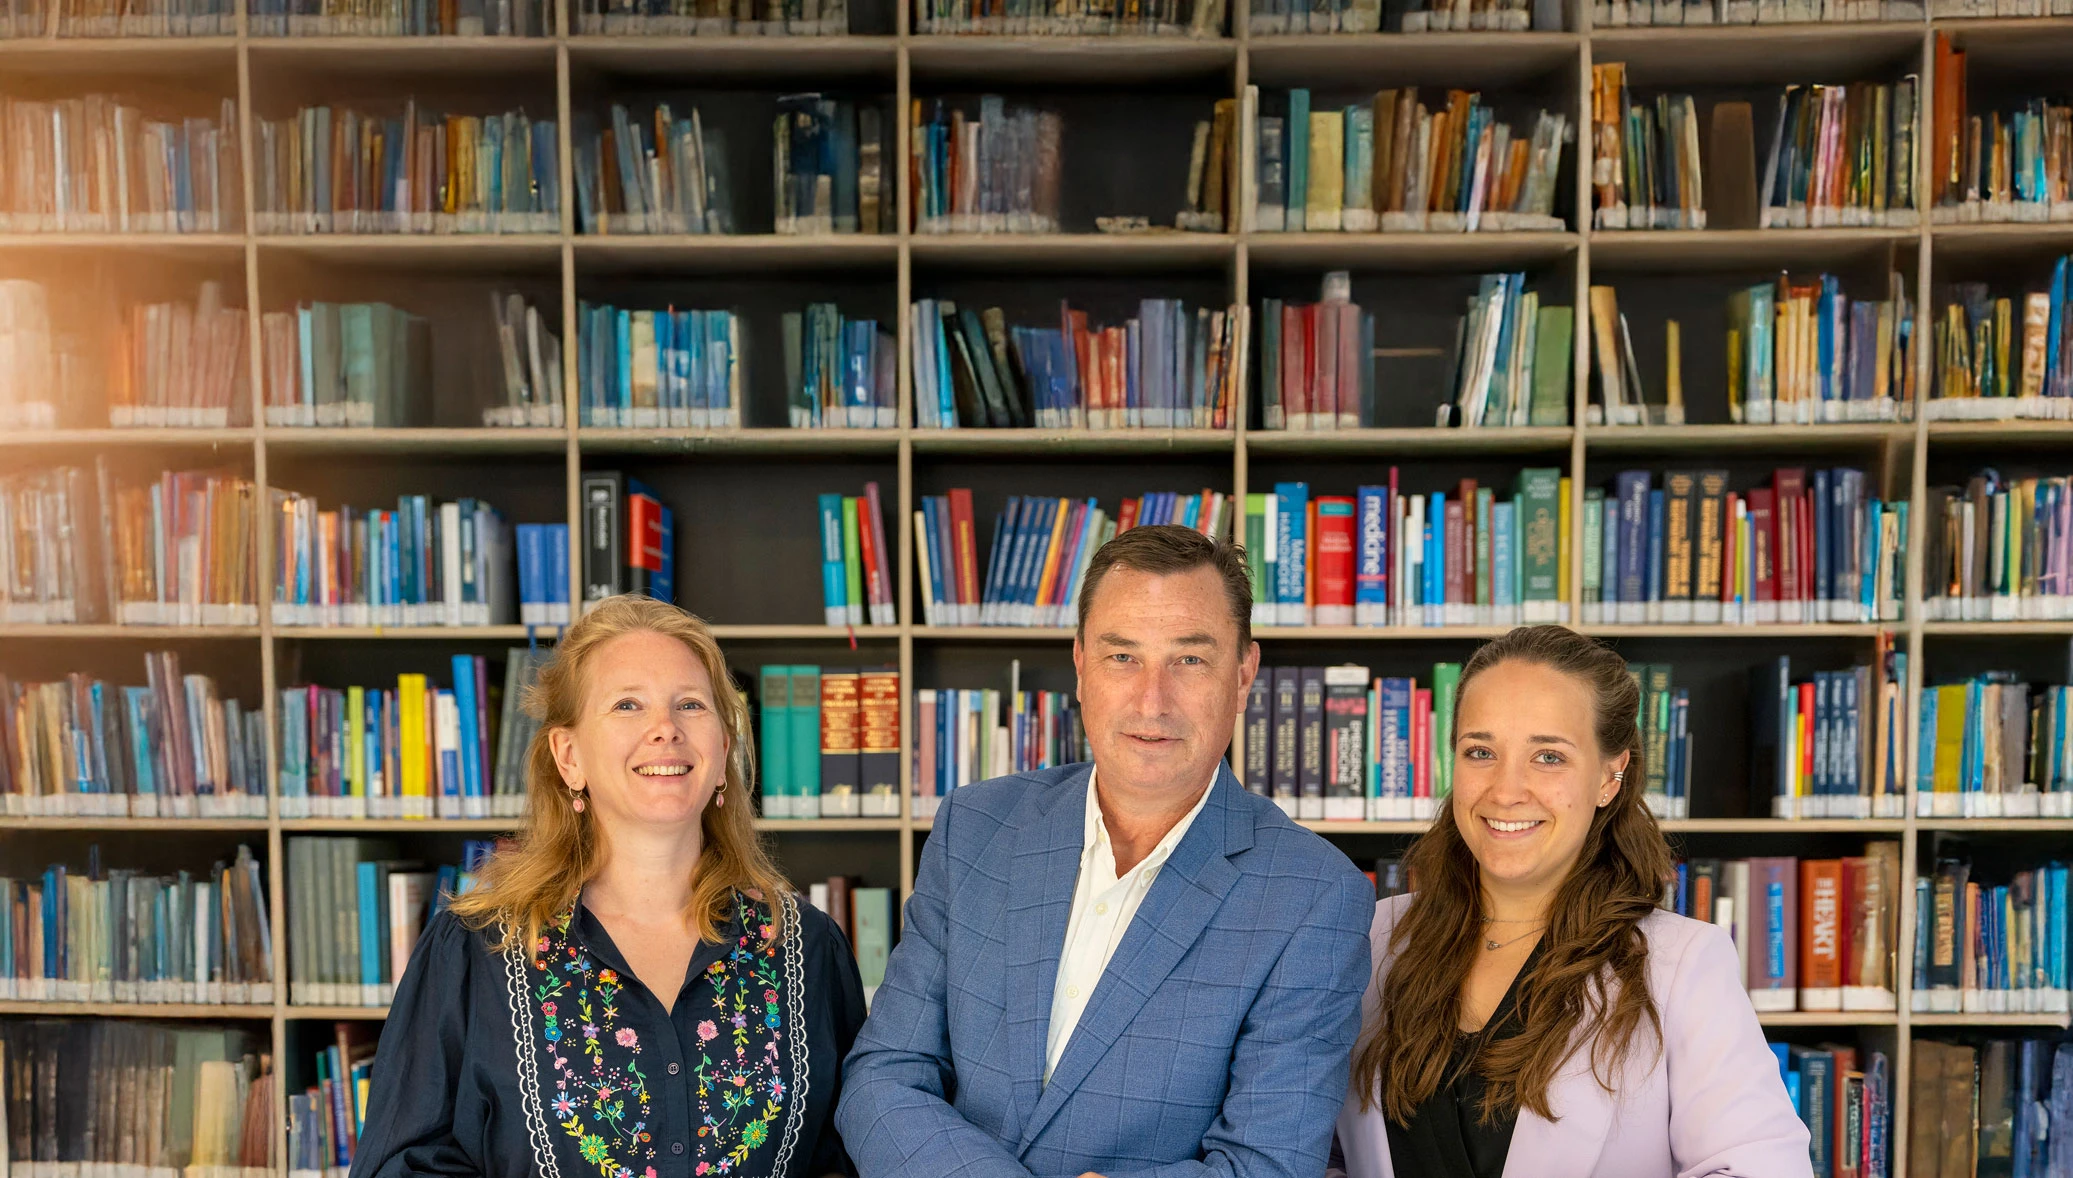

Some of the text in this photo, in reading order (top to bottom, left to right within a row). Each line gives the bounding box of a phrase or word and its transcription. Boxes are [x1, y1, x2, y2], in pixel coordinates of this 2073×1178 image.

[1278, 512, 1291, 596] HANDBOEK
[1291, 538, 1306, 597] Medisch
[1363, 496, 1386, 575] medicine
[1338, 727, 1350, 785] MEDICINE
[1349, 720, 1363, 793] EMERGENCY
[1813, 888, 1837, 960] HEART
